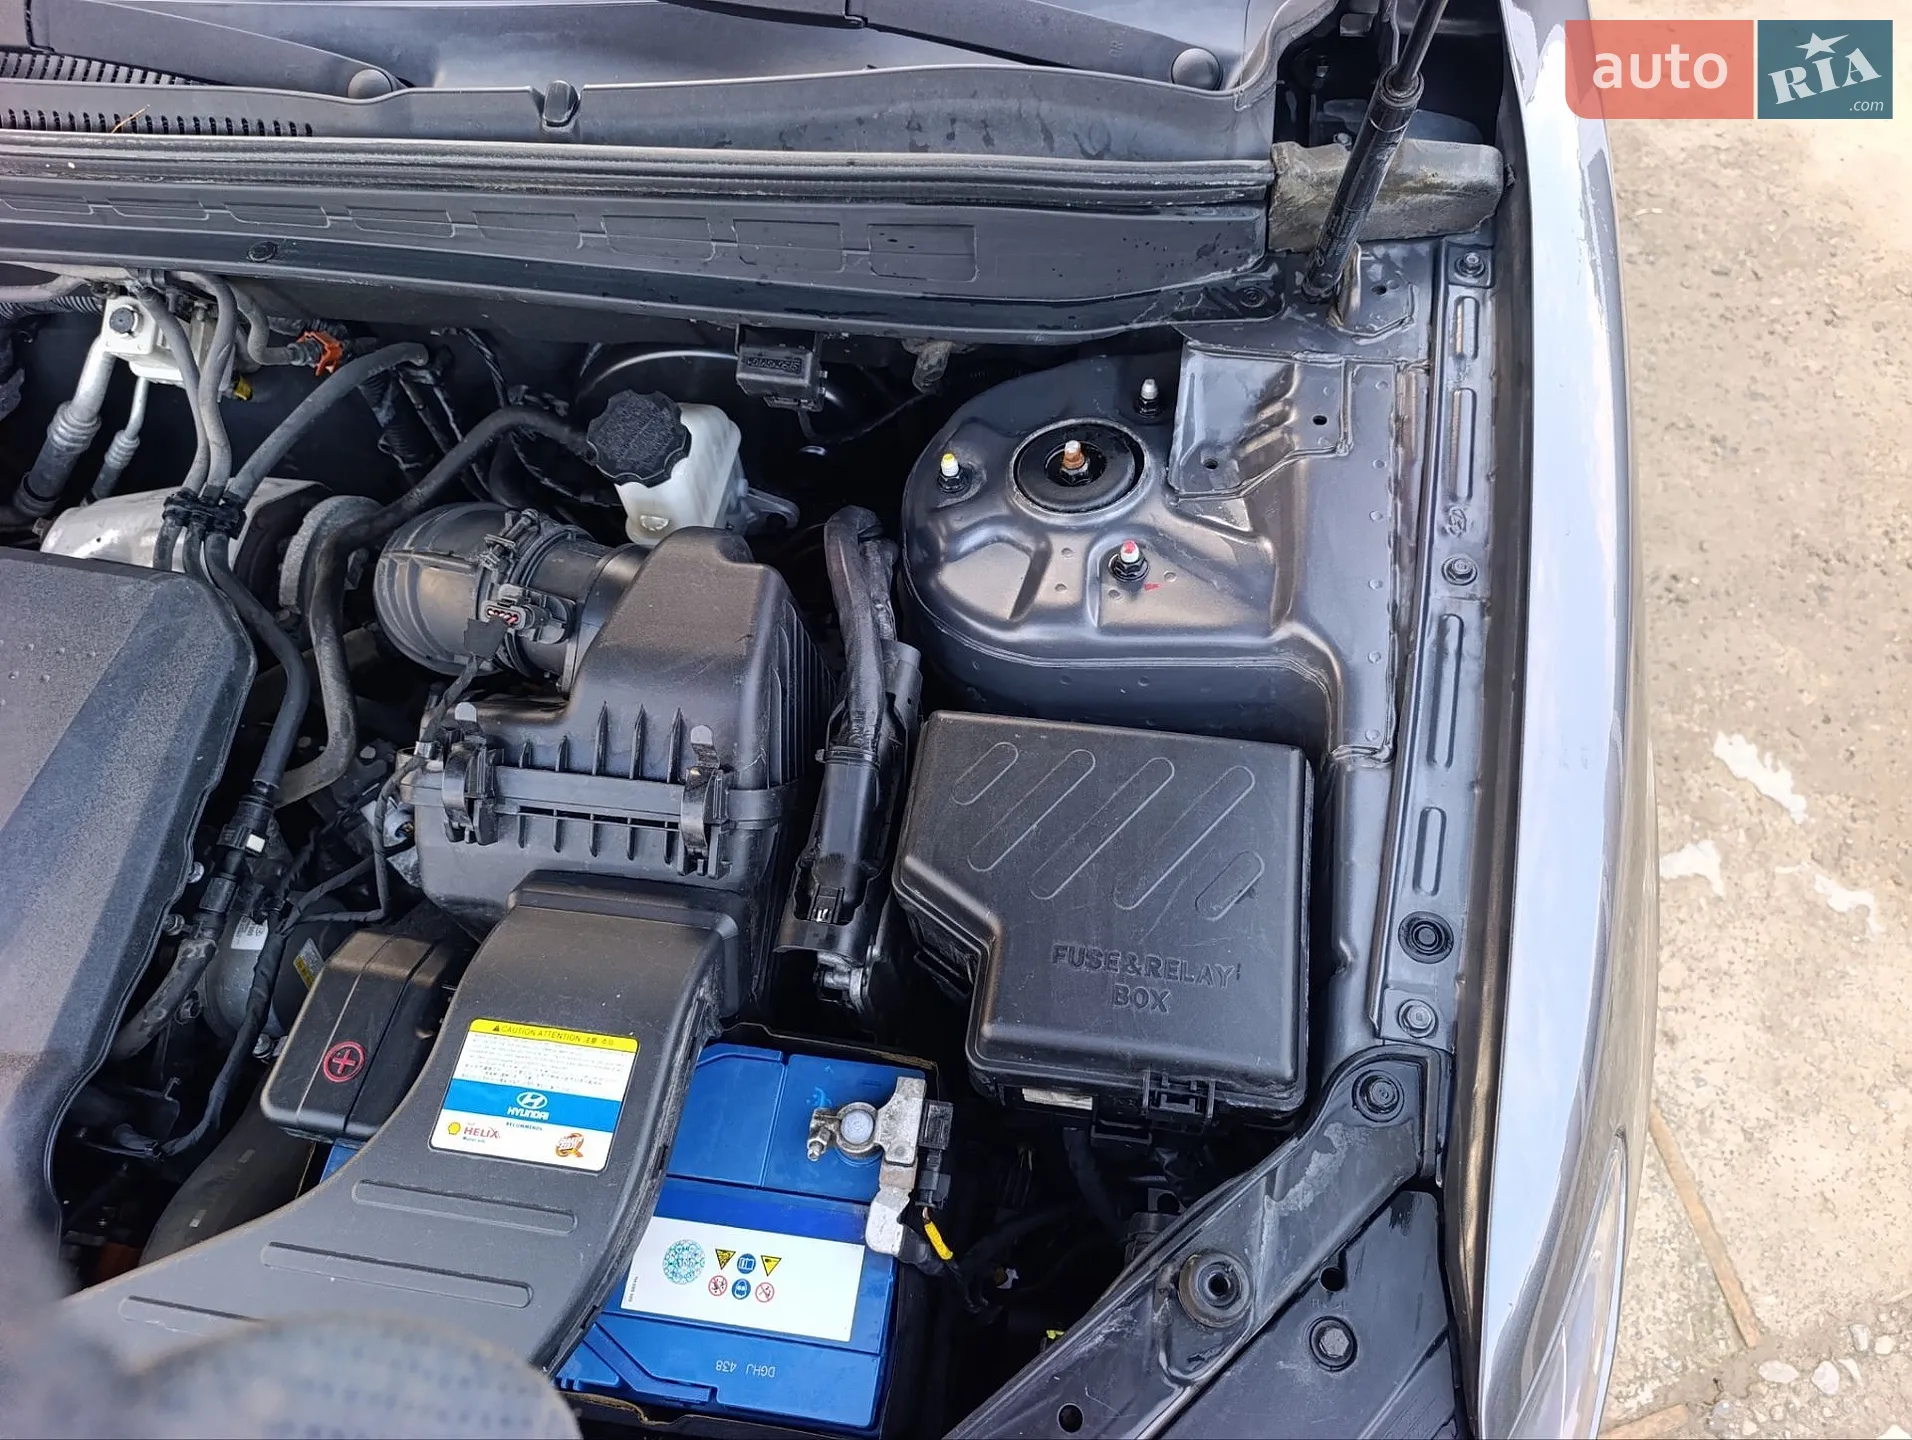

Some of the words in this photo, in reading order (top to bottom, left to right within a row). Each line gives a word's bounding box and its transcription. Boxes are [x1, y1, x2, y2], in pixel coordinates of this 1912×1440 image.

[1112, 982, 1172, 1014] BOX
[501, 1025, 536, 1037] CAUTION
[537, 1028, 581, 1043] ATTENTION
[507, 1107, 550, 1121] HYUNDAI
[463, 1125, 499, 1139] HELIX
[715, 1359, 737, 1373] 438
[745, 1363, 776, 1378] DGHJ
